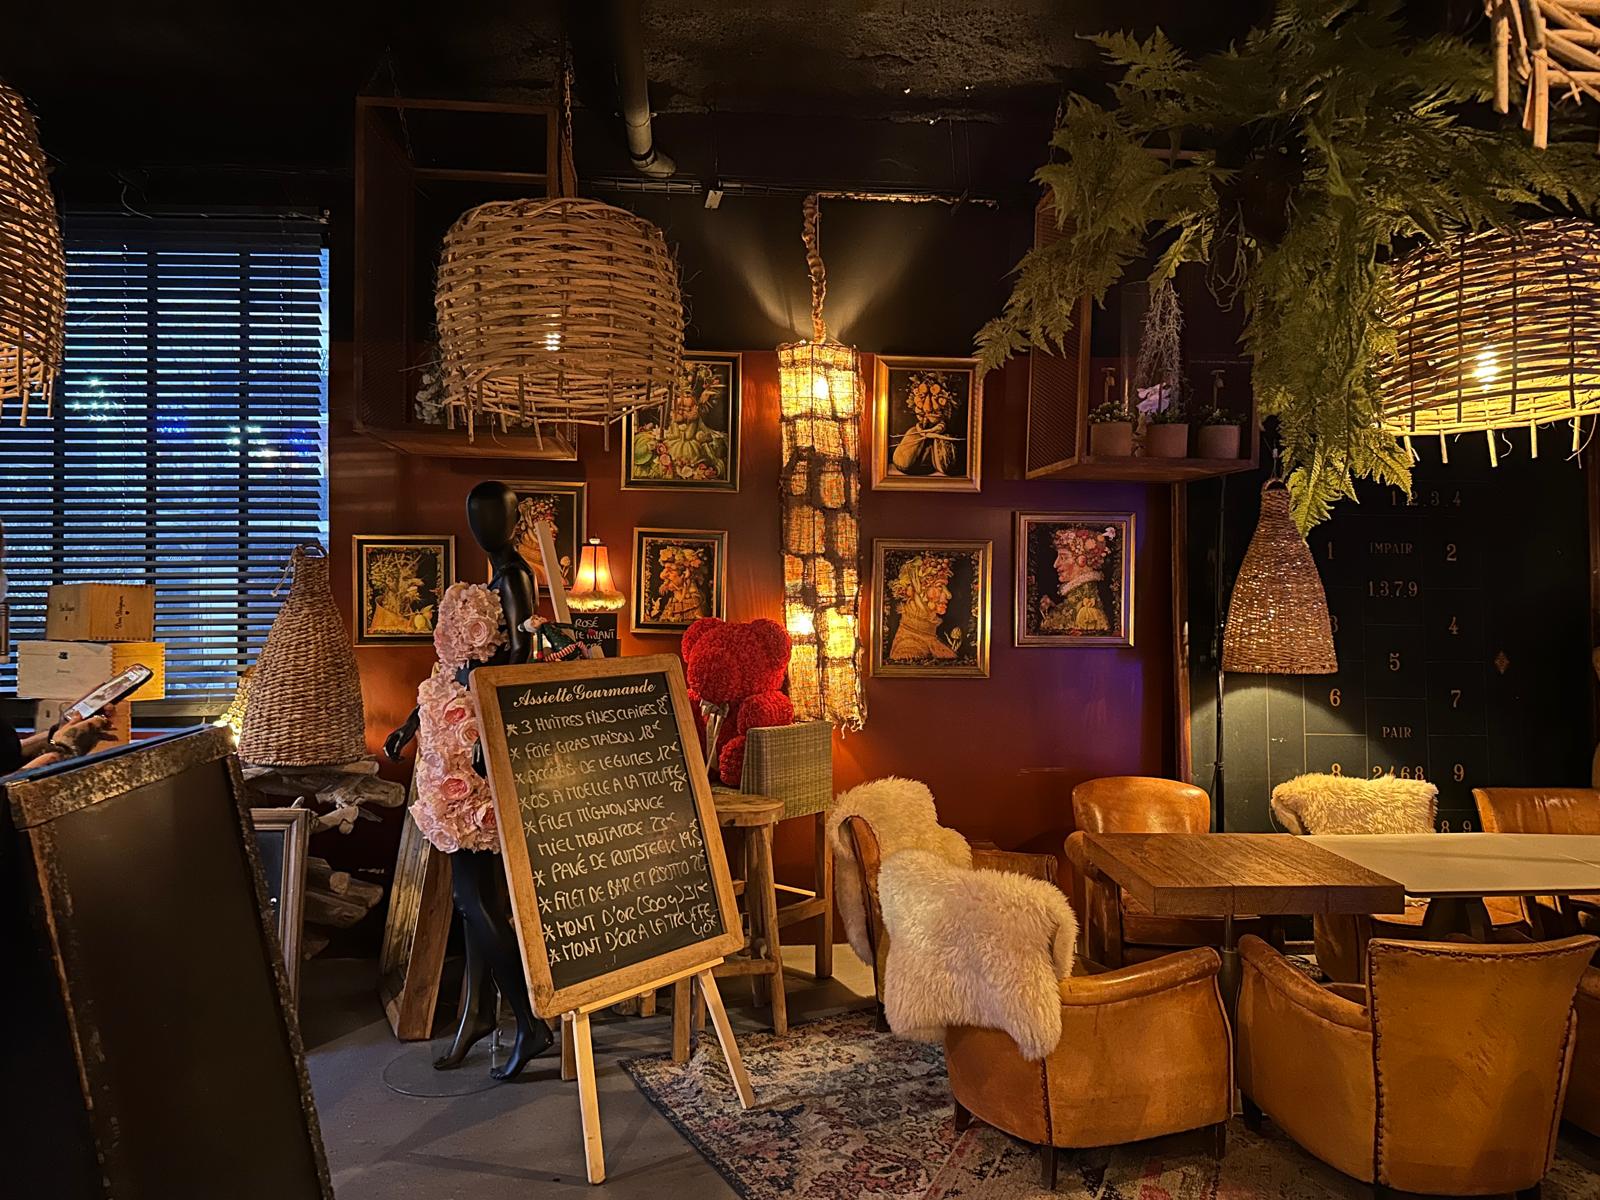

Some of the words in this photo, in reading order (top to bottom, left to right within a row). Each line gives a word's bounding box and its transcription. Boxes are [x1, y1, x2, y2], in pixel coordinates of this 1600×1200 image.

[1327, 541, 1336, 560] 1
[1369, 542, 1414, 555] IMPAIR
[1445, 543, 1457, 562] 2
[575, 616, 599, 628] ROSÉ
[1448, 616, 1460, 635] 4
[1389, 652, 1401, 671] 5
[513, 687, 574, 707] Assiette
[573, 678, 657, 700] Gourmande
[1329, 688, 1342, 707] 6
[1450, 689, 1462, 708] 7
[521, 719, 533, 735] 3
[585, 710, 617, 725] FINES
[616, 704, 657, 720] CLAIRES
[1382, 726, 1413, 739] PAIR
[525, 742, 552, 760] FOIE
[556, 737, 590, 753] GRAS
[591, 730, 635, 746] MAISON
[581, 759, 597, 774] DE
[598, 751, 653, 771] LEGUMES
[1453, 763, 1465, 782] 9
[531, 792, 550, 808] OS
[552, 789, 564, 804] A
[565, 780, 611, 800] MOELLE
[613, 778, 624, 793] A
[623, 774, 640, 790] LA
[638, 764, 683, 788] TRUFFE
[538, 811, 575, 833] FILET
[577, 801, 627, 823] MIGNON
[627, 795, 665, 813] SAUCE
[537, 837, 575, 857] MIEL
[575, 821, 644, 848] MOUTARDE
[551, 852, 588, 883] PAVÉ
[589, 851, 608, 871] DE
[554, 888, 586, 911] FILET
[588, 886, 606, 904] DE
[607, 876, 634, 900] BAR
[633, 871, 646, 890] ET
[648, 860, 690, 887] RISOTTO
[556, 914, 595, 938] MONT
[602, 905, 637, 927] D'OR
[562, 936, 601, 961] MONT
[605, 927, 637, 951] D'OR
[638, 922, 650, 941] A
[649, 918, 668, 936] LA
[664, 902, 713, 930] TRUFFE
